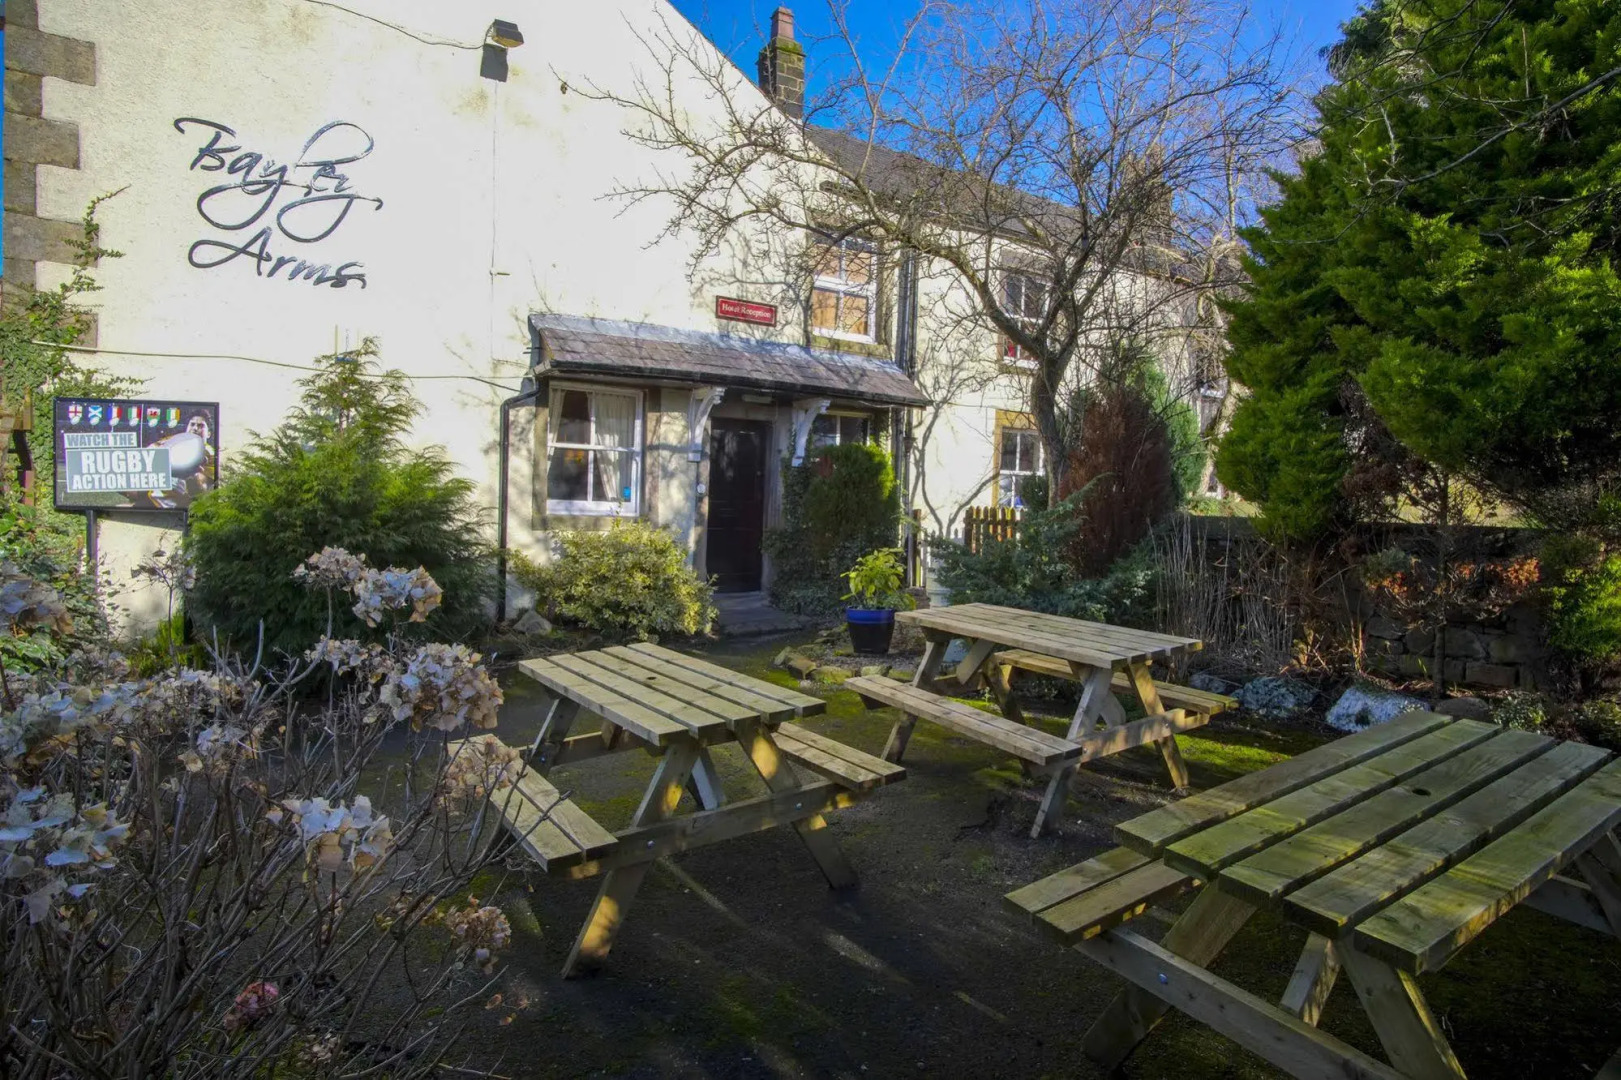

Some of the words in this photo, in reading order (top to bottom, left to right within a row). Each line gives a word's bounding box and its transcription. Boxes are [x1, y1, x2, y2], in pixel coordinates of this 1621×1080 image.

[173, 118, 383, 243] Bayley
[188, 226, 367, 289] Arms
[722, 303, 739, 313] Hotel
[742, 307, 771, 318] Reception
[68, 434, 108, 447] WATCH
[111, 433, 134, 446] THE
[81, 450, 156, 474] RUGBY
[72, 474, 127, 490] ACTION
[130, 473, 167, 488] HERE
